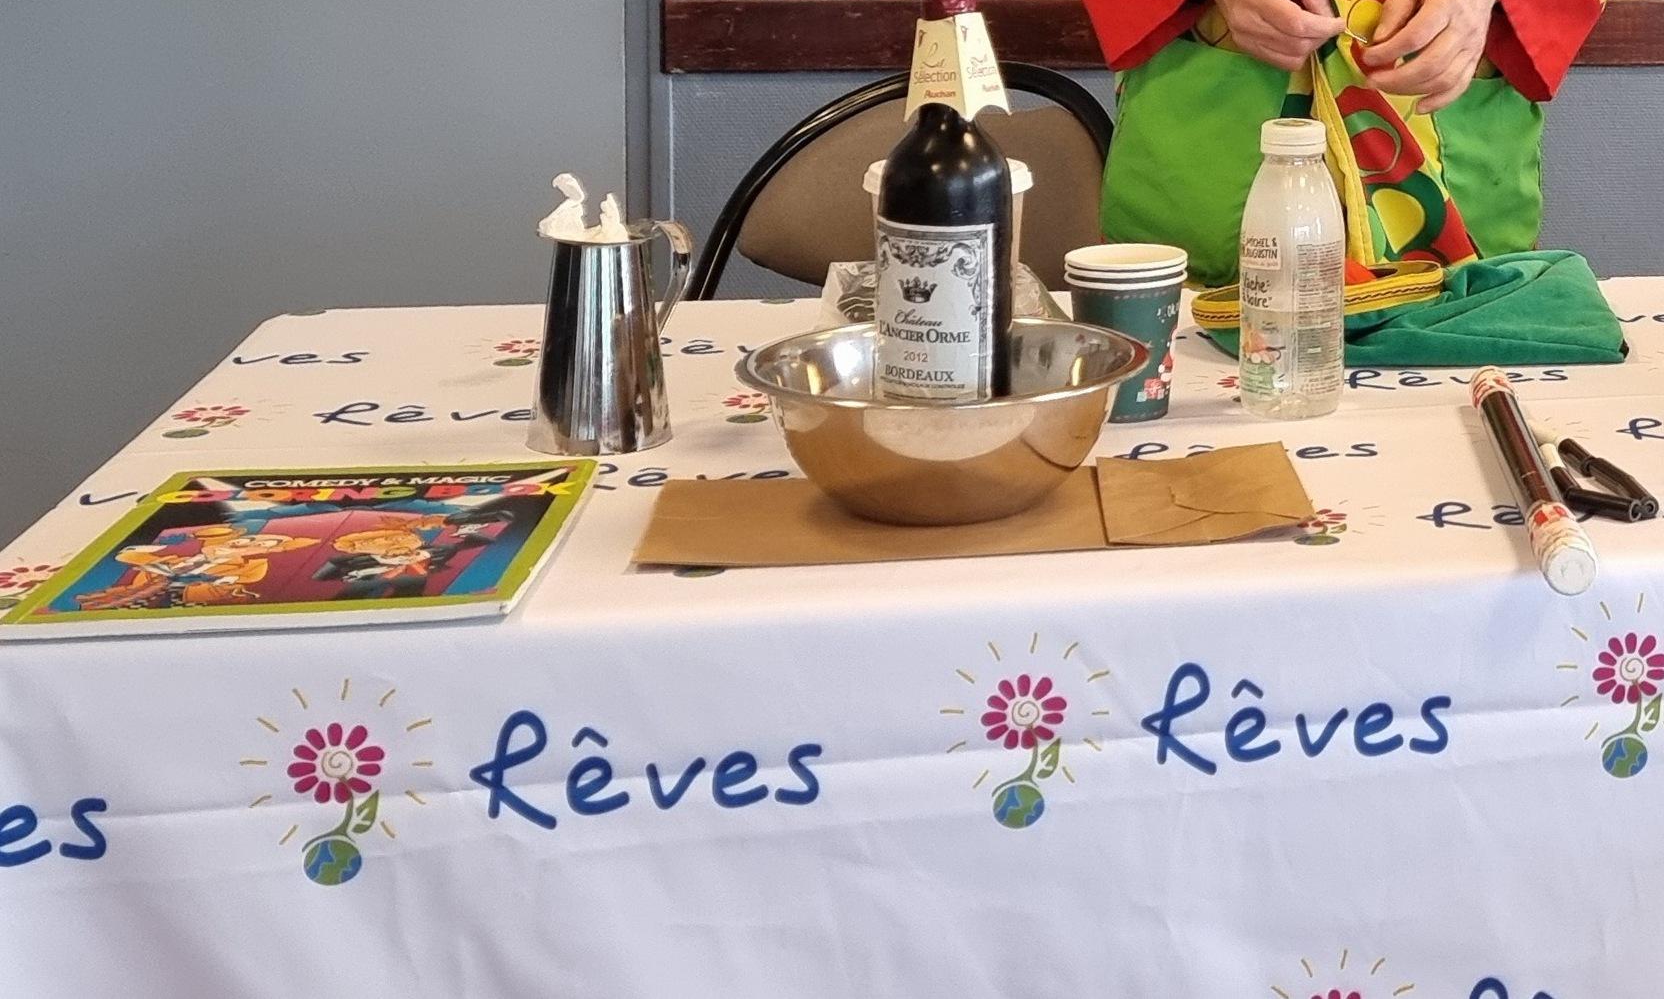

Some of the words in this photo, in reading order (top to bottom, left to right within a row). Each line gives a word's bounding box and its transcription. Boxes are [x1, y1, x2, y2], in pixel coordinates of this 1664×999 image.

[924, 89, 956, 99] Auchan
[894, 308, 943, 327] Château
[926, 328, 971, 344] ORME
[903, 351, 928, 363] 2012
[885, 364, 954, 382] BORDEAUX
[313, 401, 537, 426] Rêve
[244, 478, 380, 489] COMEDY
[381, 476, 402, 487] &
[406, 474, 512, 485] MAGIC
[426, 481, 571, 499] BOOK
[1140, 662, 1452, 776] Rêves
[469, 710, 822, 830] Rêves
